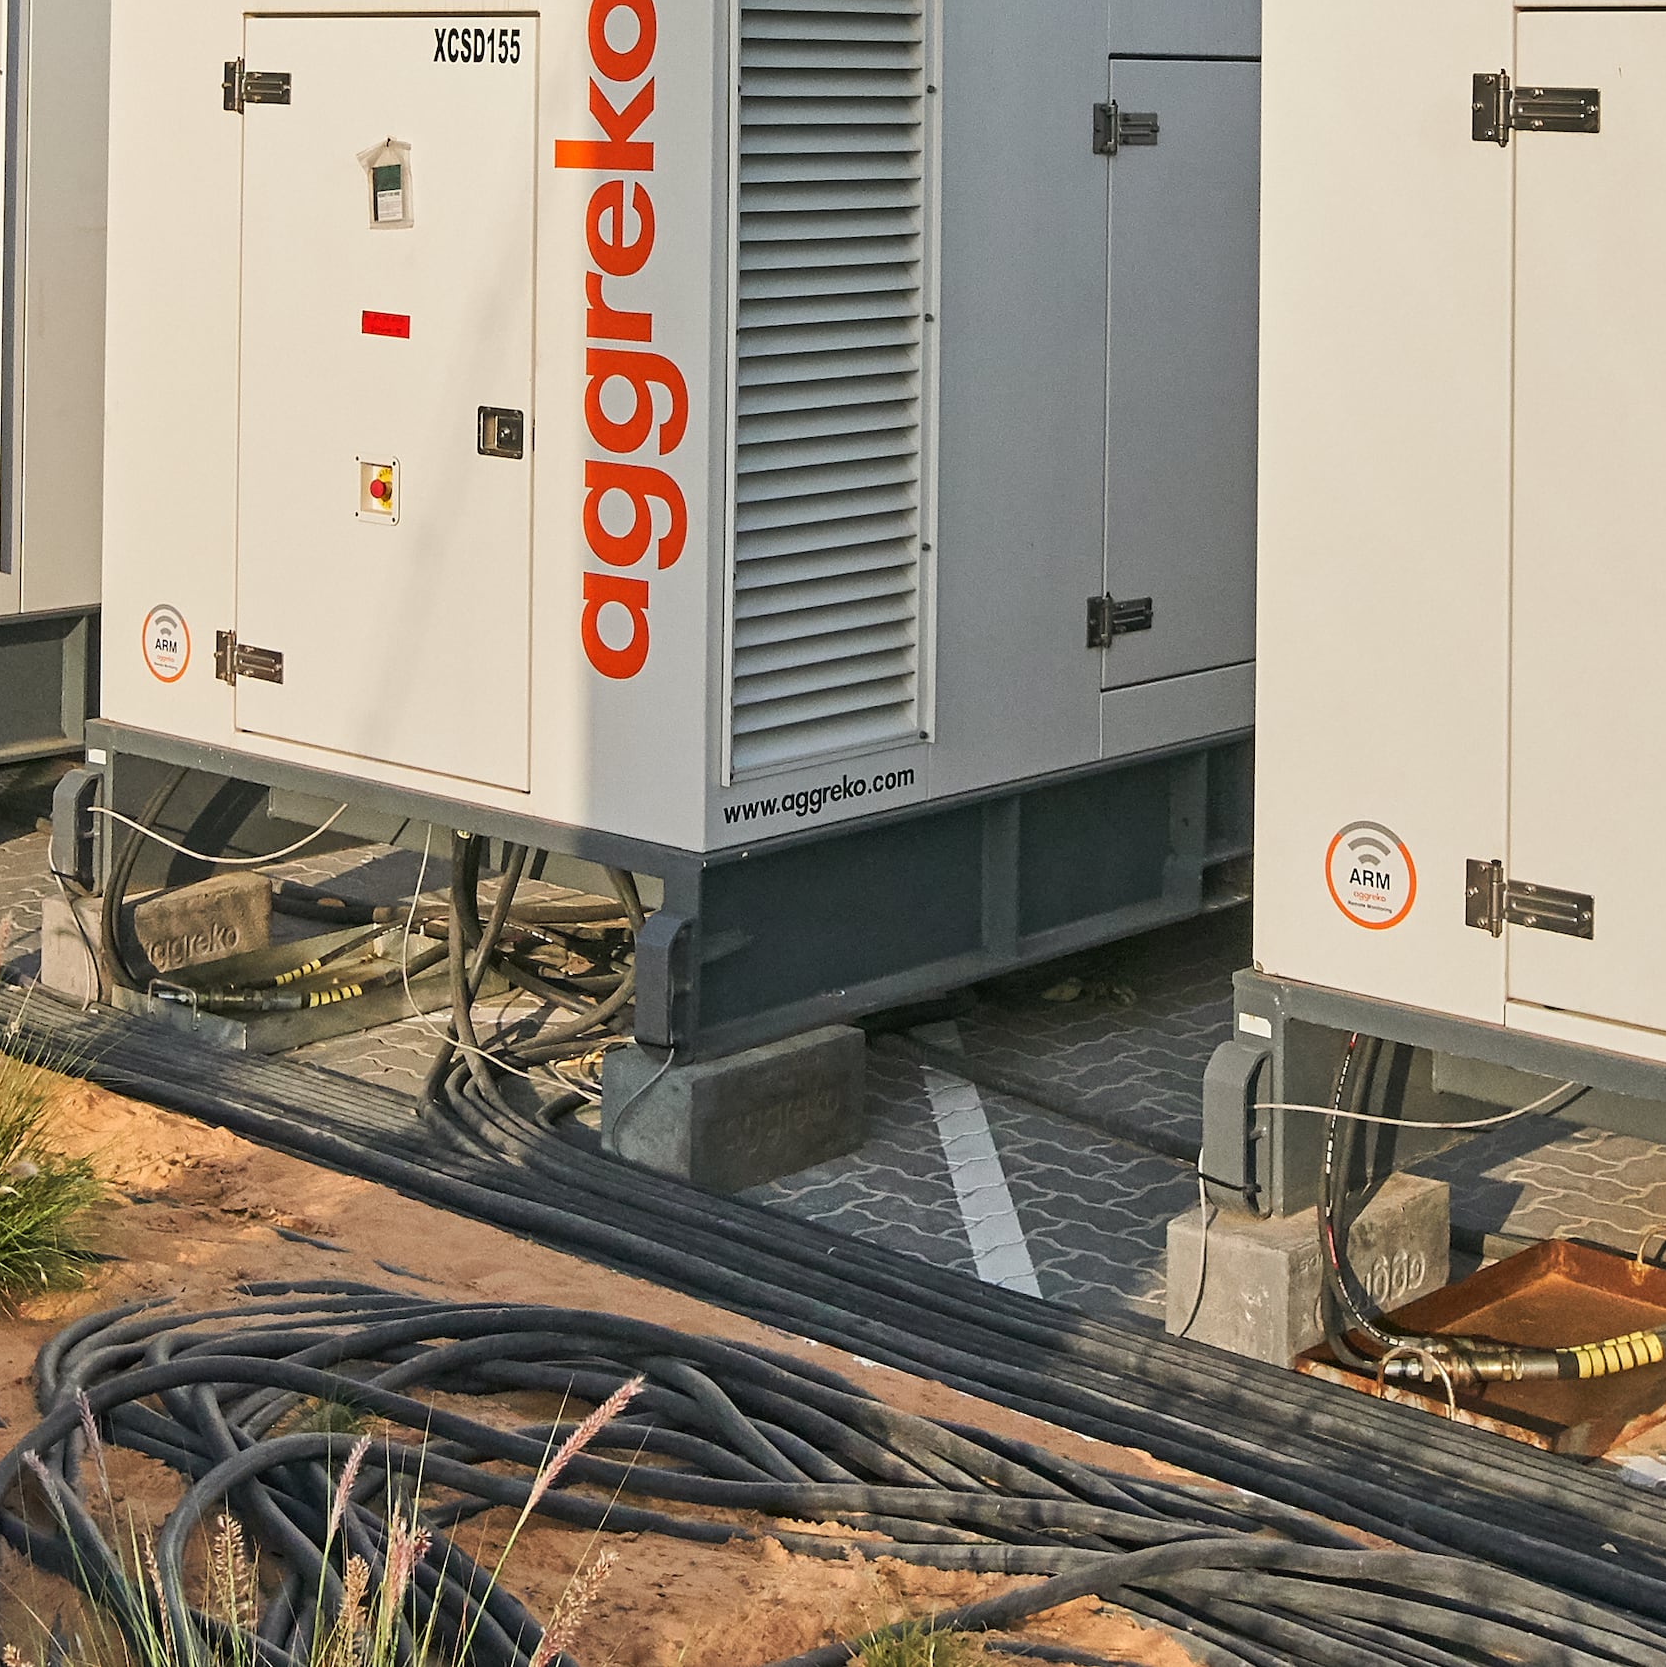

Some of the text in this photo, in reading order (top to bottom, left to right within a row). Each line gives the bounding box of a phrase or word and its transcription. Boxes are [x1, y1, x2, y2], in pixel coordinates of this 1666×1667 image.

[433, 27, 521, 64] XCSD155
[155, 638, 177, 653] ARM
[723, 768, 915, 824] www.aggreko.com
[1349, 868, 1390, 890] ARM
[1353, 890, 1386, 902] aggreko
